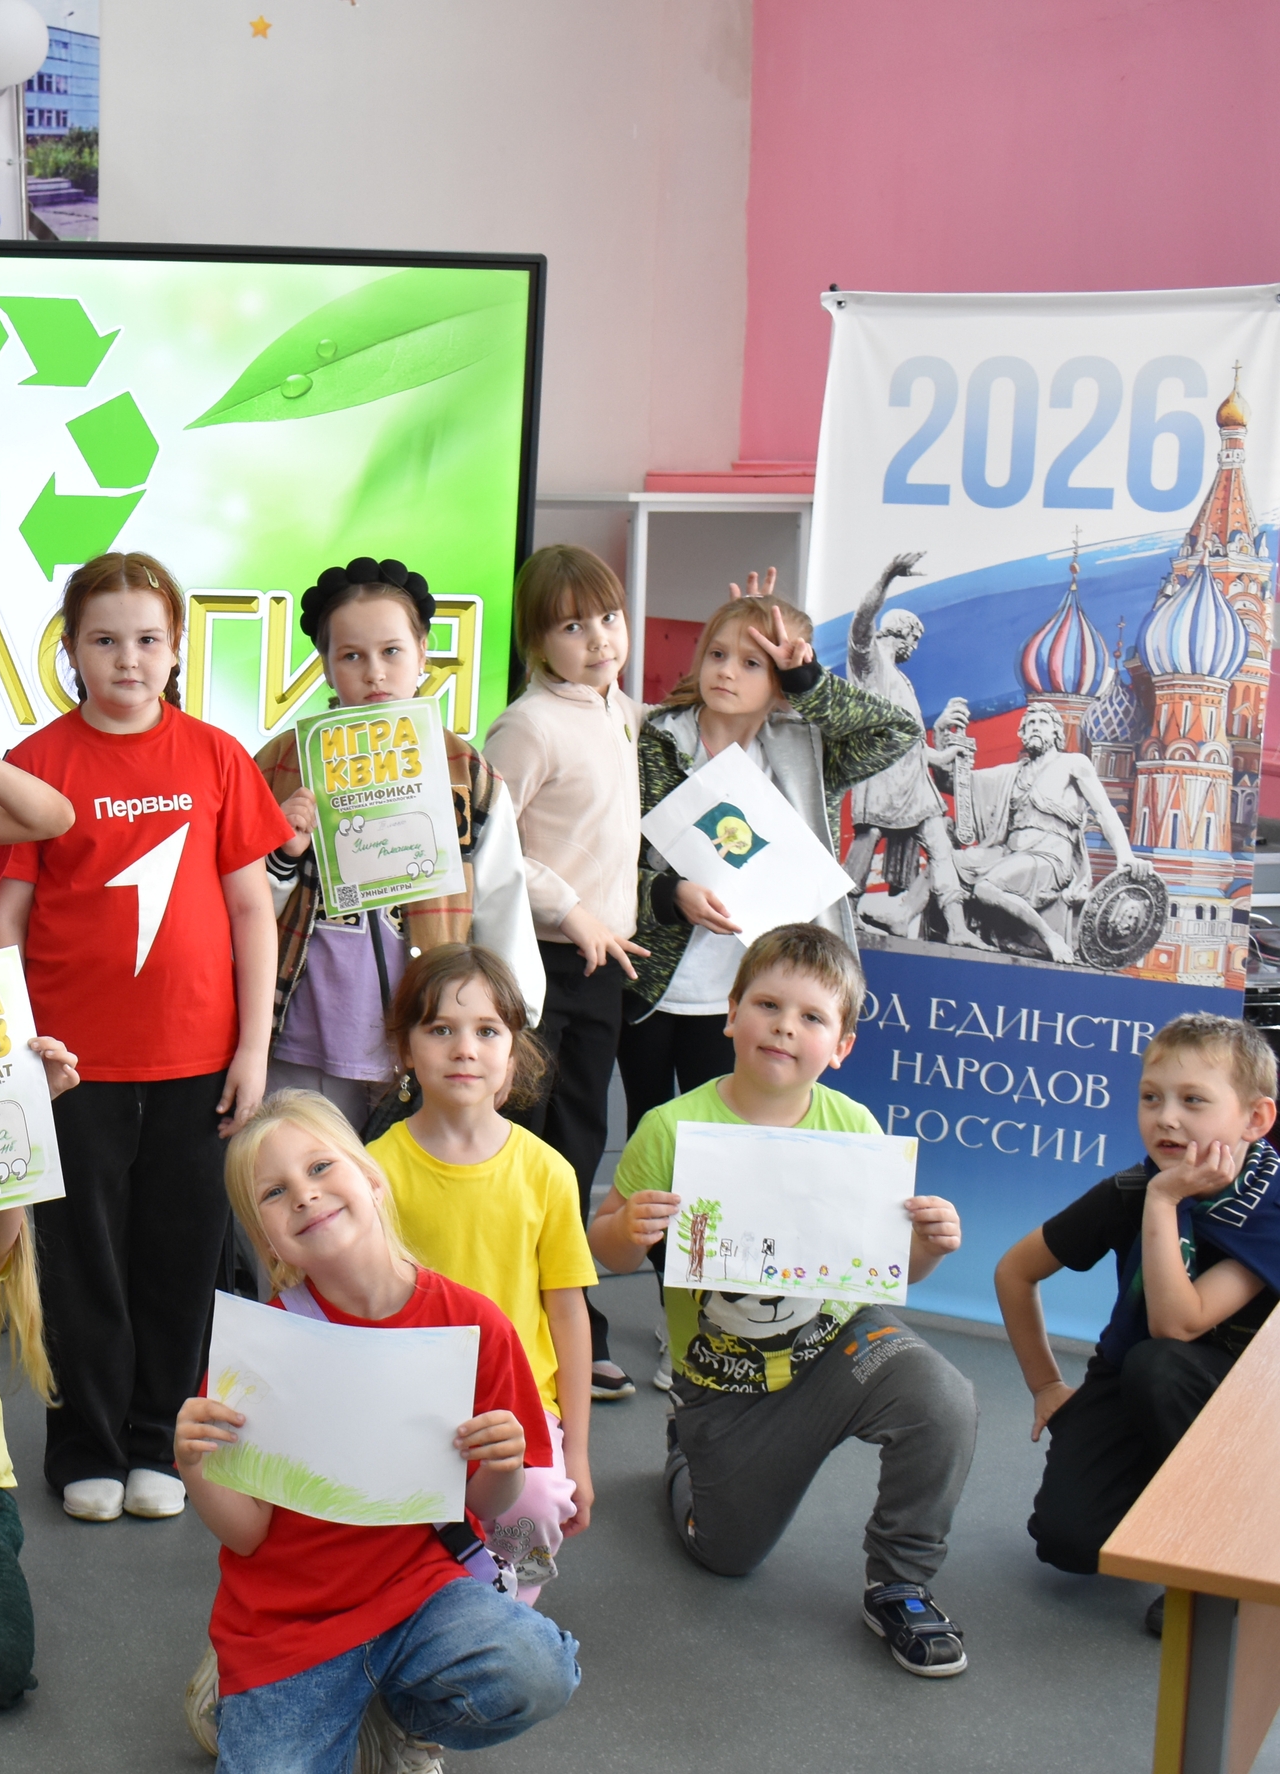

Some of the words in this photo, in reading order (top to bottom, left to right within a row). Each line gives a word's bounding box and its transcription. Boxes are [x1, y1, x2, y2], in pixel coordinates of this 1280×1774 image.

[882, 355, 1208, 513] 2026
[322, 717, 418, 760] ИГРА
[325, 748, 422, 793] КВИЗ
[94, 793, 192, 822] Первые
[331, 783, 423, 808] СЕРТИФИКАТ
[360, 887, 388, 898] УМНЫЕ
[390, 883, 412, 894] ИГРЫ
[857, 989, 911, 1033] ОД
[929, 997, 1155, 1056] ЕДИНСТВ
[890, 1049, 1111, 1109] НАРОДОВ
[887, 1104, 1107, 1167] РОССИИ
